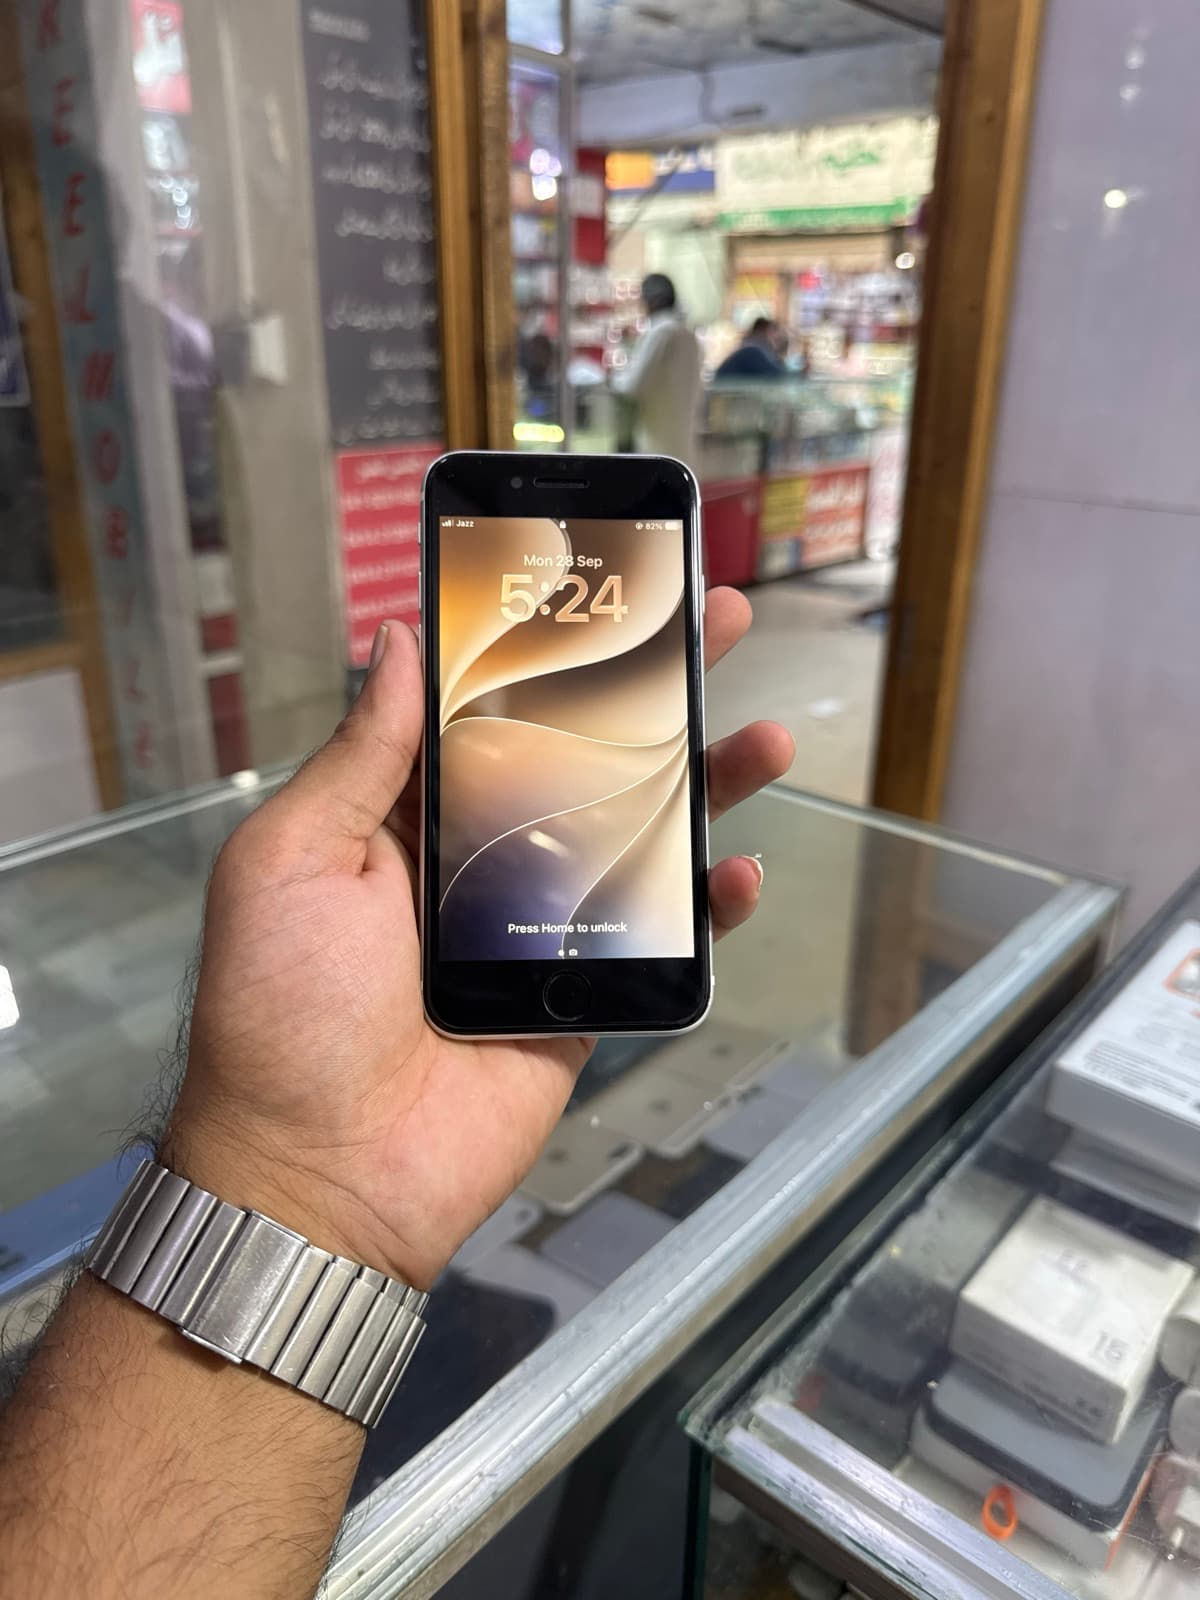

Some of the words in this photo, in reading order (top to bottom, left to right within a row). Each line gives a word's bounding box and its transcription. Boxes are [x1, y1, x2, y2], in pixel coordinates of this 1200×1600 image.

[456, 519, 474, 528] Jazz
[645, 522, 663, 531] 82%
[523, 554, 552, 567] Mon
[556, 554, 574, 567] 28
[577, 555, 603, 570] Sep
[499, 573, 629, 623] 5:24
[507, 923, 540, 934] Press
[541, 923, 574, 933] Home
[577, 922, 588, 933] to
[591, 921, 628, 932] unlock
